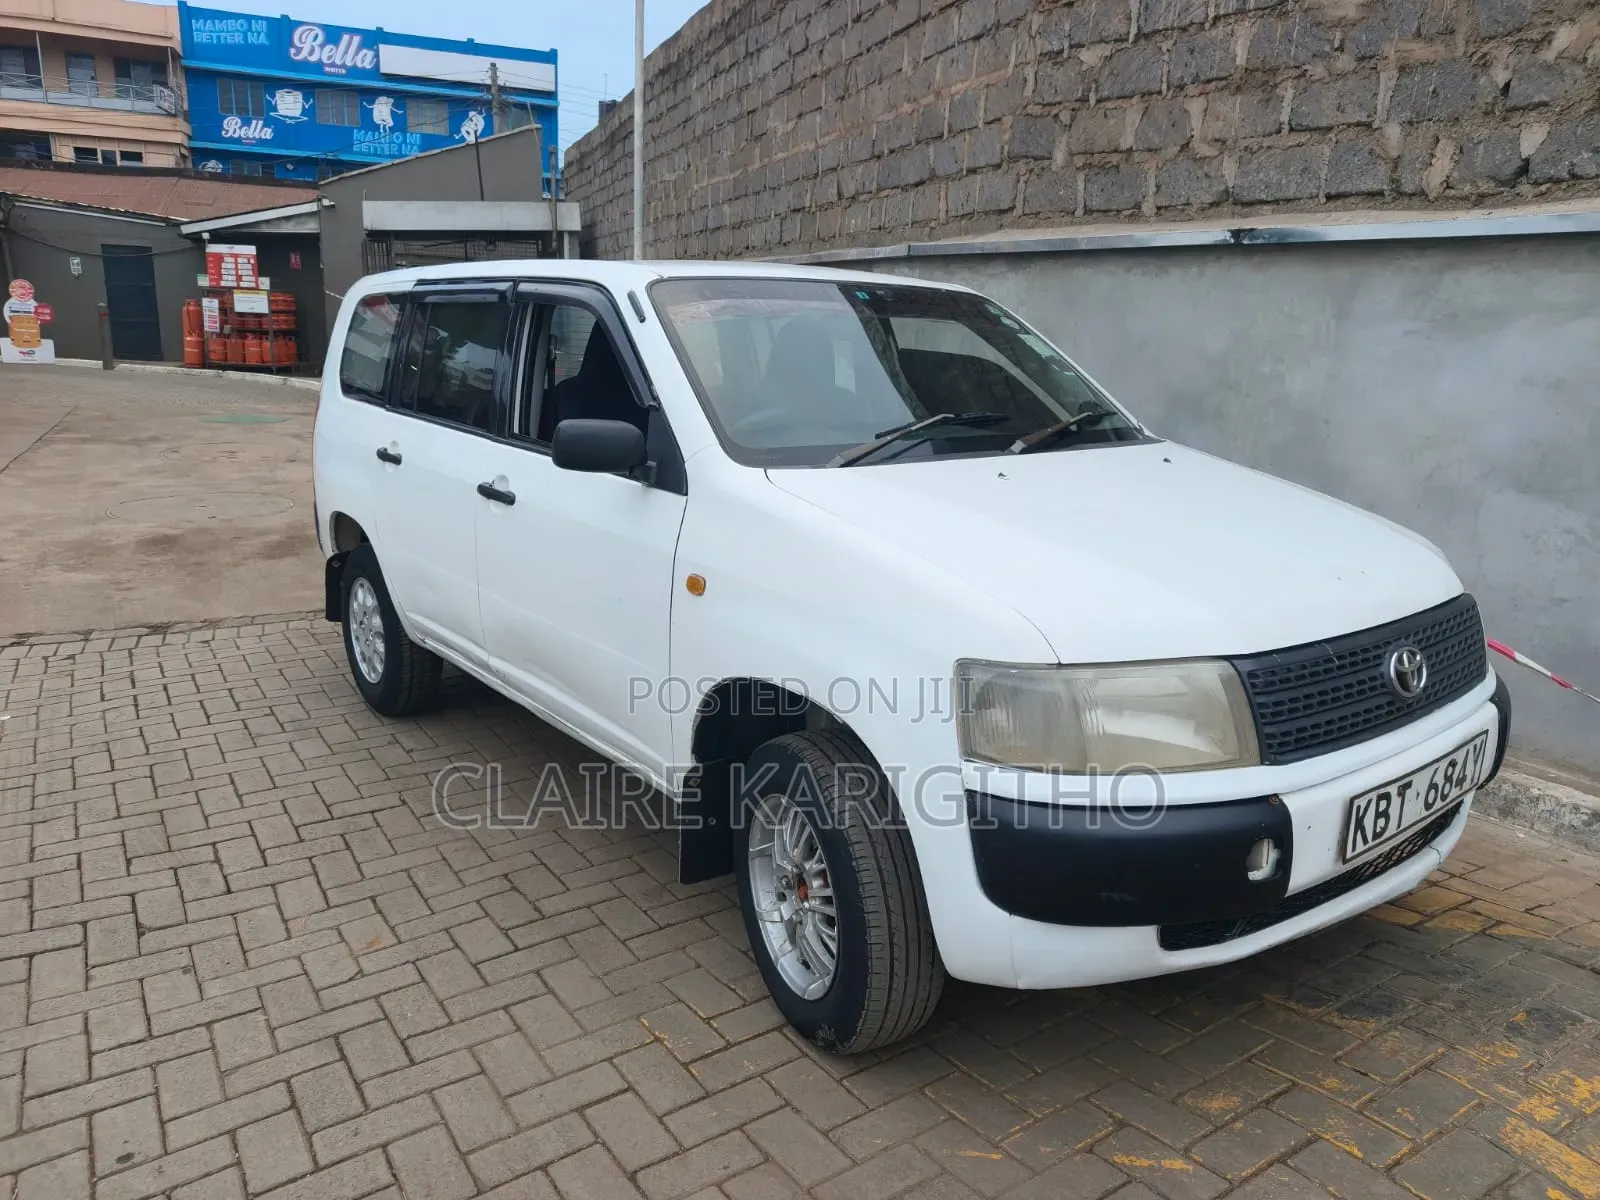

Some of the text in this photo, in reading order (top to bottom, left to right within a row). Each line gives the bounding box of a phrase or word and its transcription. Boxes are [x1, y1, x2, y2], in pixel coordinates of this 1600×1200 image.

[192, 19, 268, 32] MAMBO NI
[193, 31, 244, 44] BETTER
[289, 25, 377, 69] Bella
[221, 116, 274, 140] Bella
[1352, 739, 1484, 853] KBT 684Y
